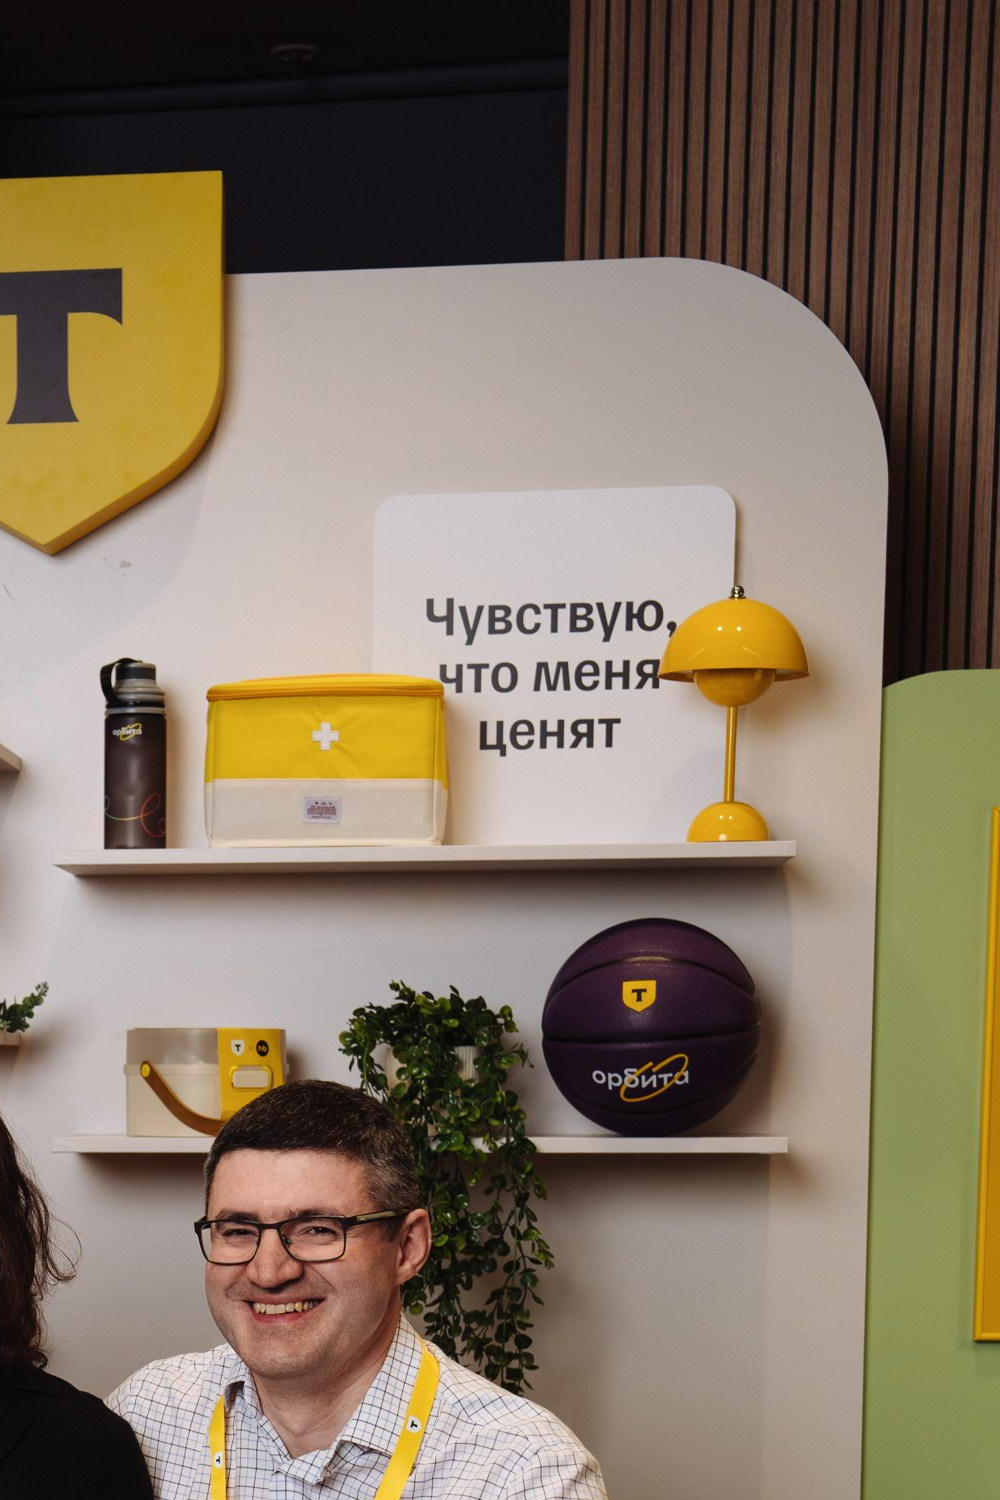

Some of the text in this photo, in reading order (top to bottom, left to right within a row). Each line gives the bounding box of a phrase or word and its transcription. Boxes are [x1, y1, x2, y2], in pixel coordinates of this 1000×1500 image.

[426, 597, 676, 645] Чувствую,
[438, 658, 659, 694] что меня
[479, 717, 621, 757] ценят
[592, 1066, 689, 1092] орбита
